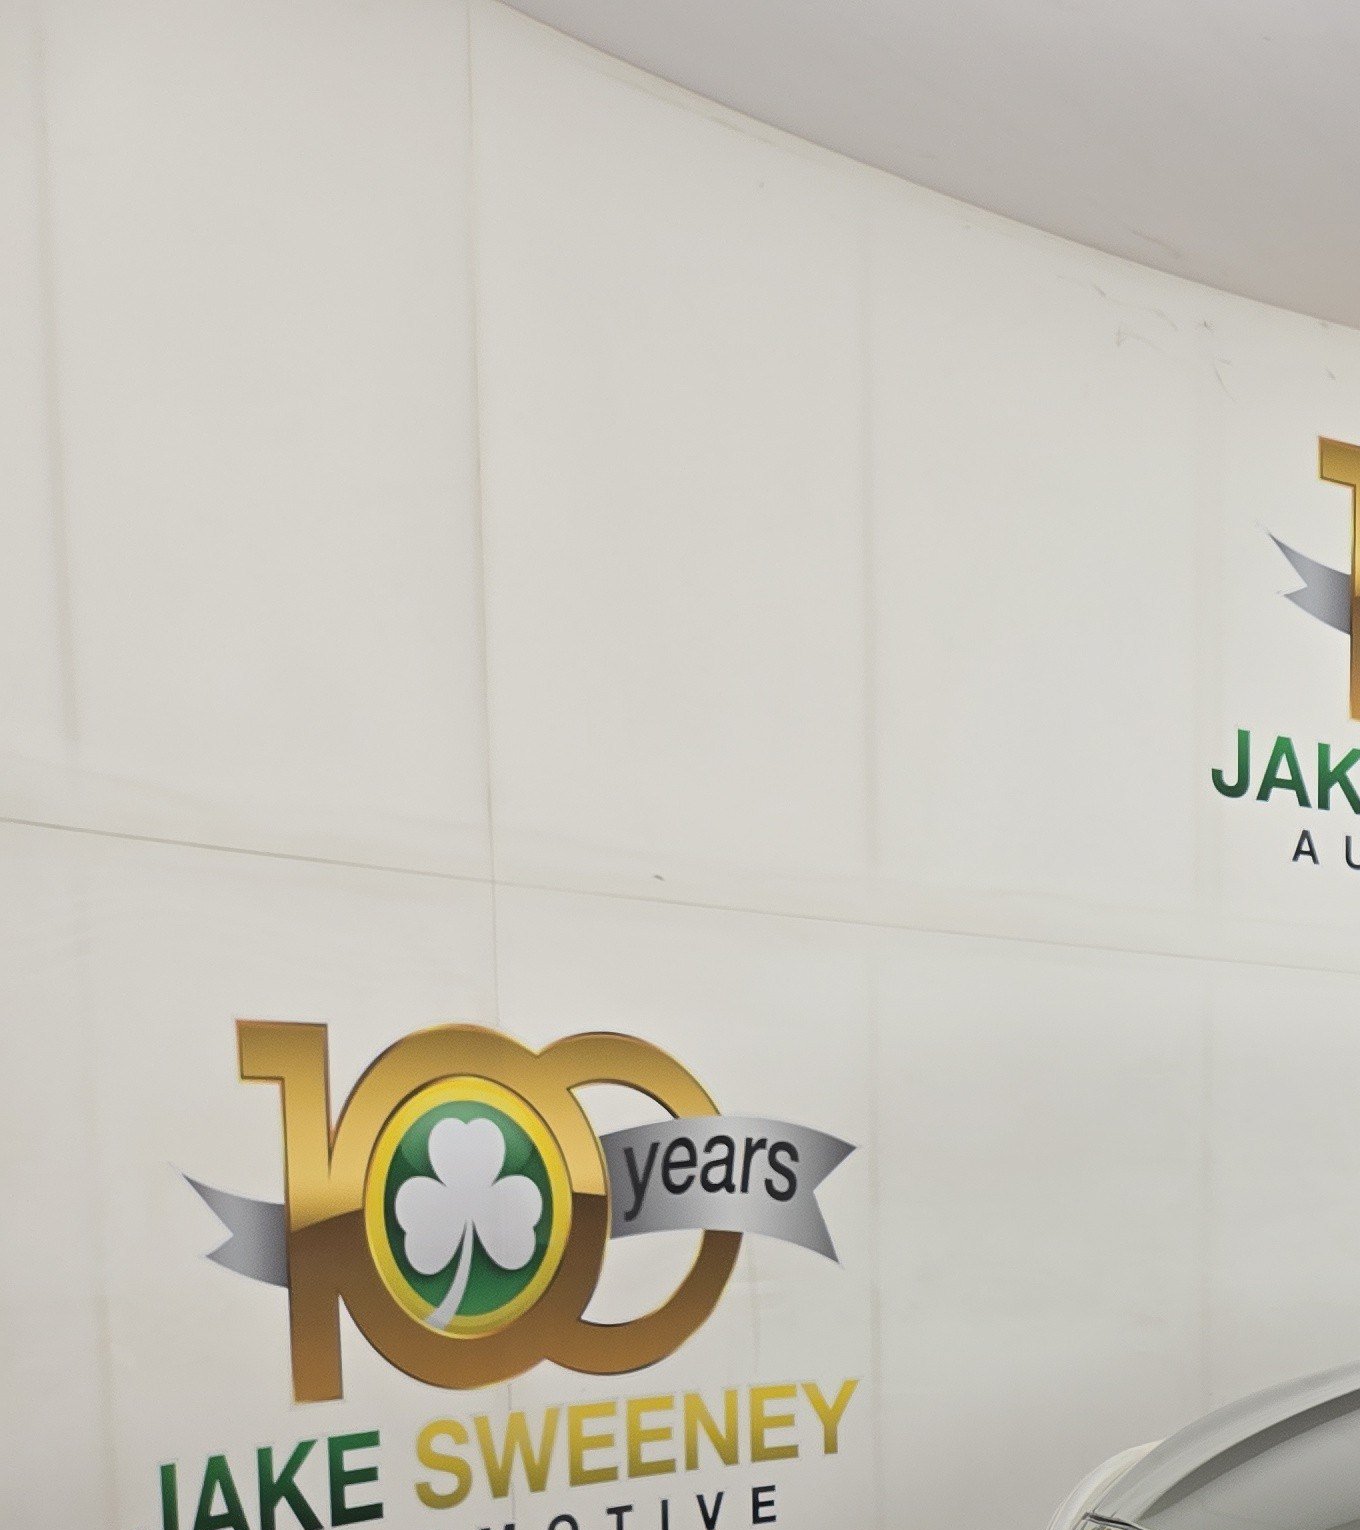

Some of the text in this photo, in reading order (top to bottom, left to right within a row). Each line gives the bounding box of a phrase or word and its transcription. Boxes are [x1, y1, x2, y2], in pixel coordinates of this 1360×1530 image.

[235, 1019, 799, 1404] 100 years
[413, 1379, 860, 1511] SWEENEY
